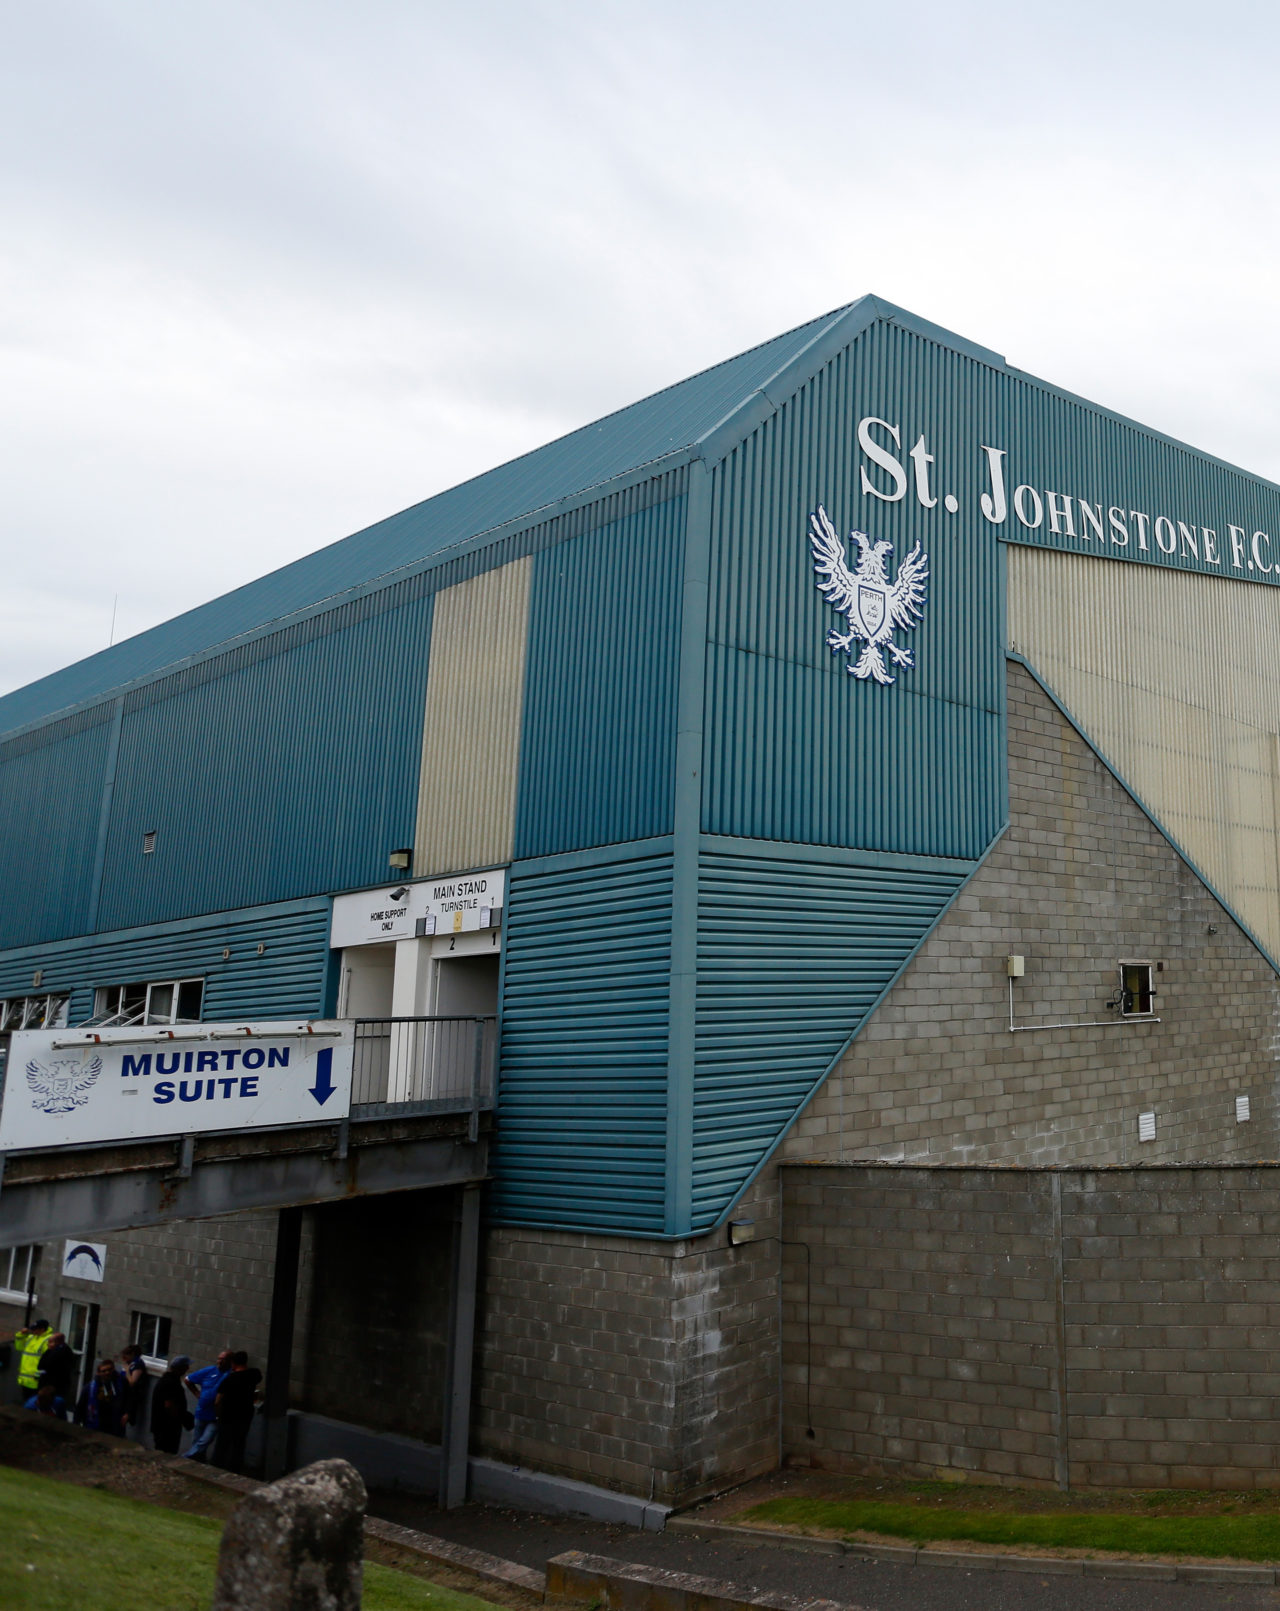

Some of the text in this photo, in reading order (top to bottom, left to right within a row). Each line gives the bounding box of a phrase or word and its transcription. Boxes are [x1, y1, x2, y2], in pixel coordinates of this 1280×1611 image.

[857, 416, 959, 513] St.
[1226, 523, 1280, 574] F.C.
[860, 589, 882, 602] PERTH
[433, 880, 487, 900] MAIN STAND
[441, 898, 478, 913] TURNSTILE
[491, 896, 495, 906] 1
[370, 908, 407, 921] HOME SUPPORT
[425, 906, 430, 914] 2
[381, 922, 393, 931] ONLY
[449, 937, 455, 950] 2
[492, 932, 497, 946] 1
[121, 1047, 290, 1077] MUIRTON
[153, 1076, 259, 1104] SUITE
